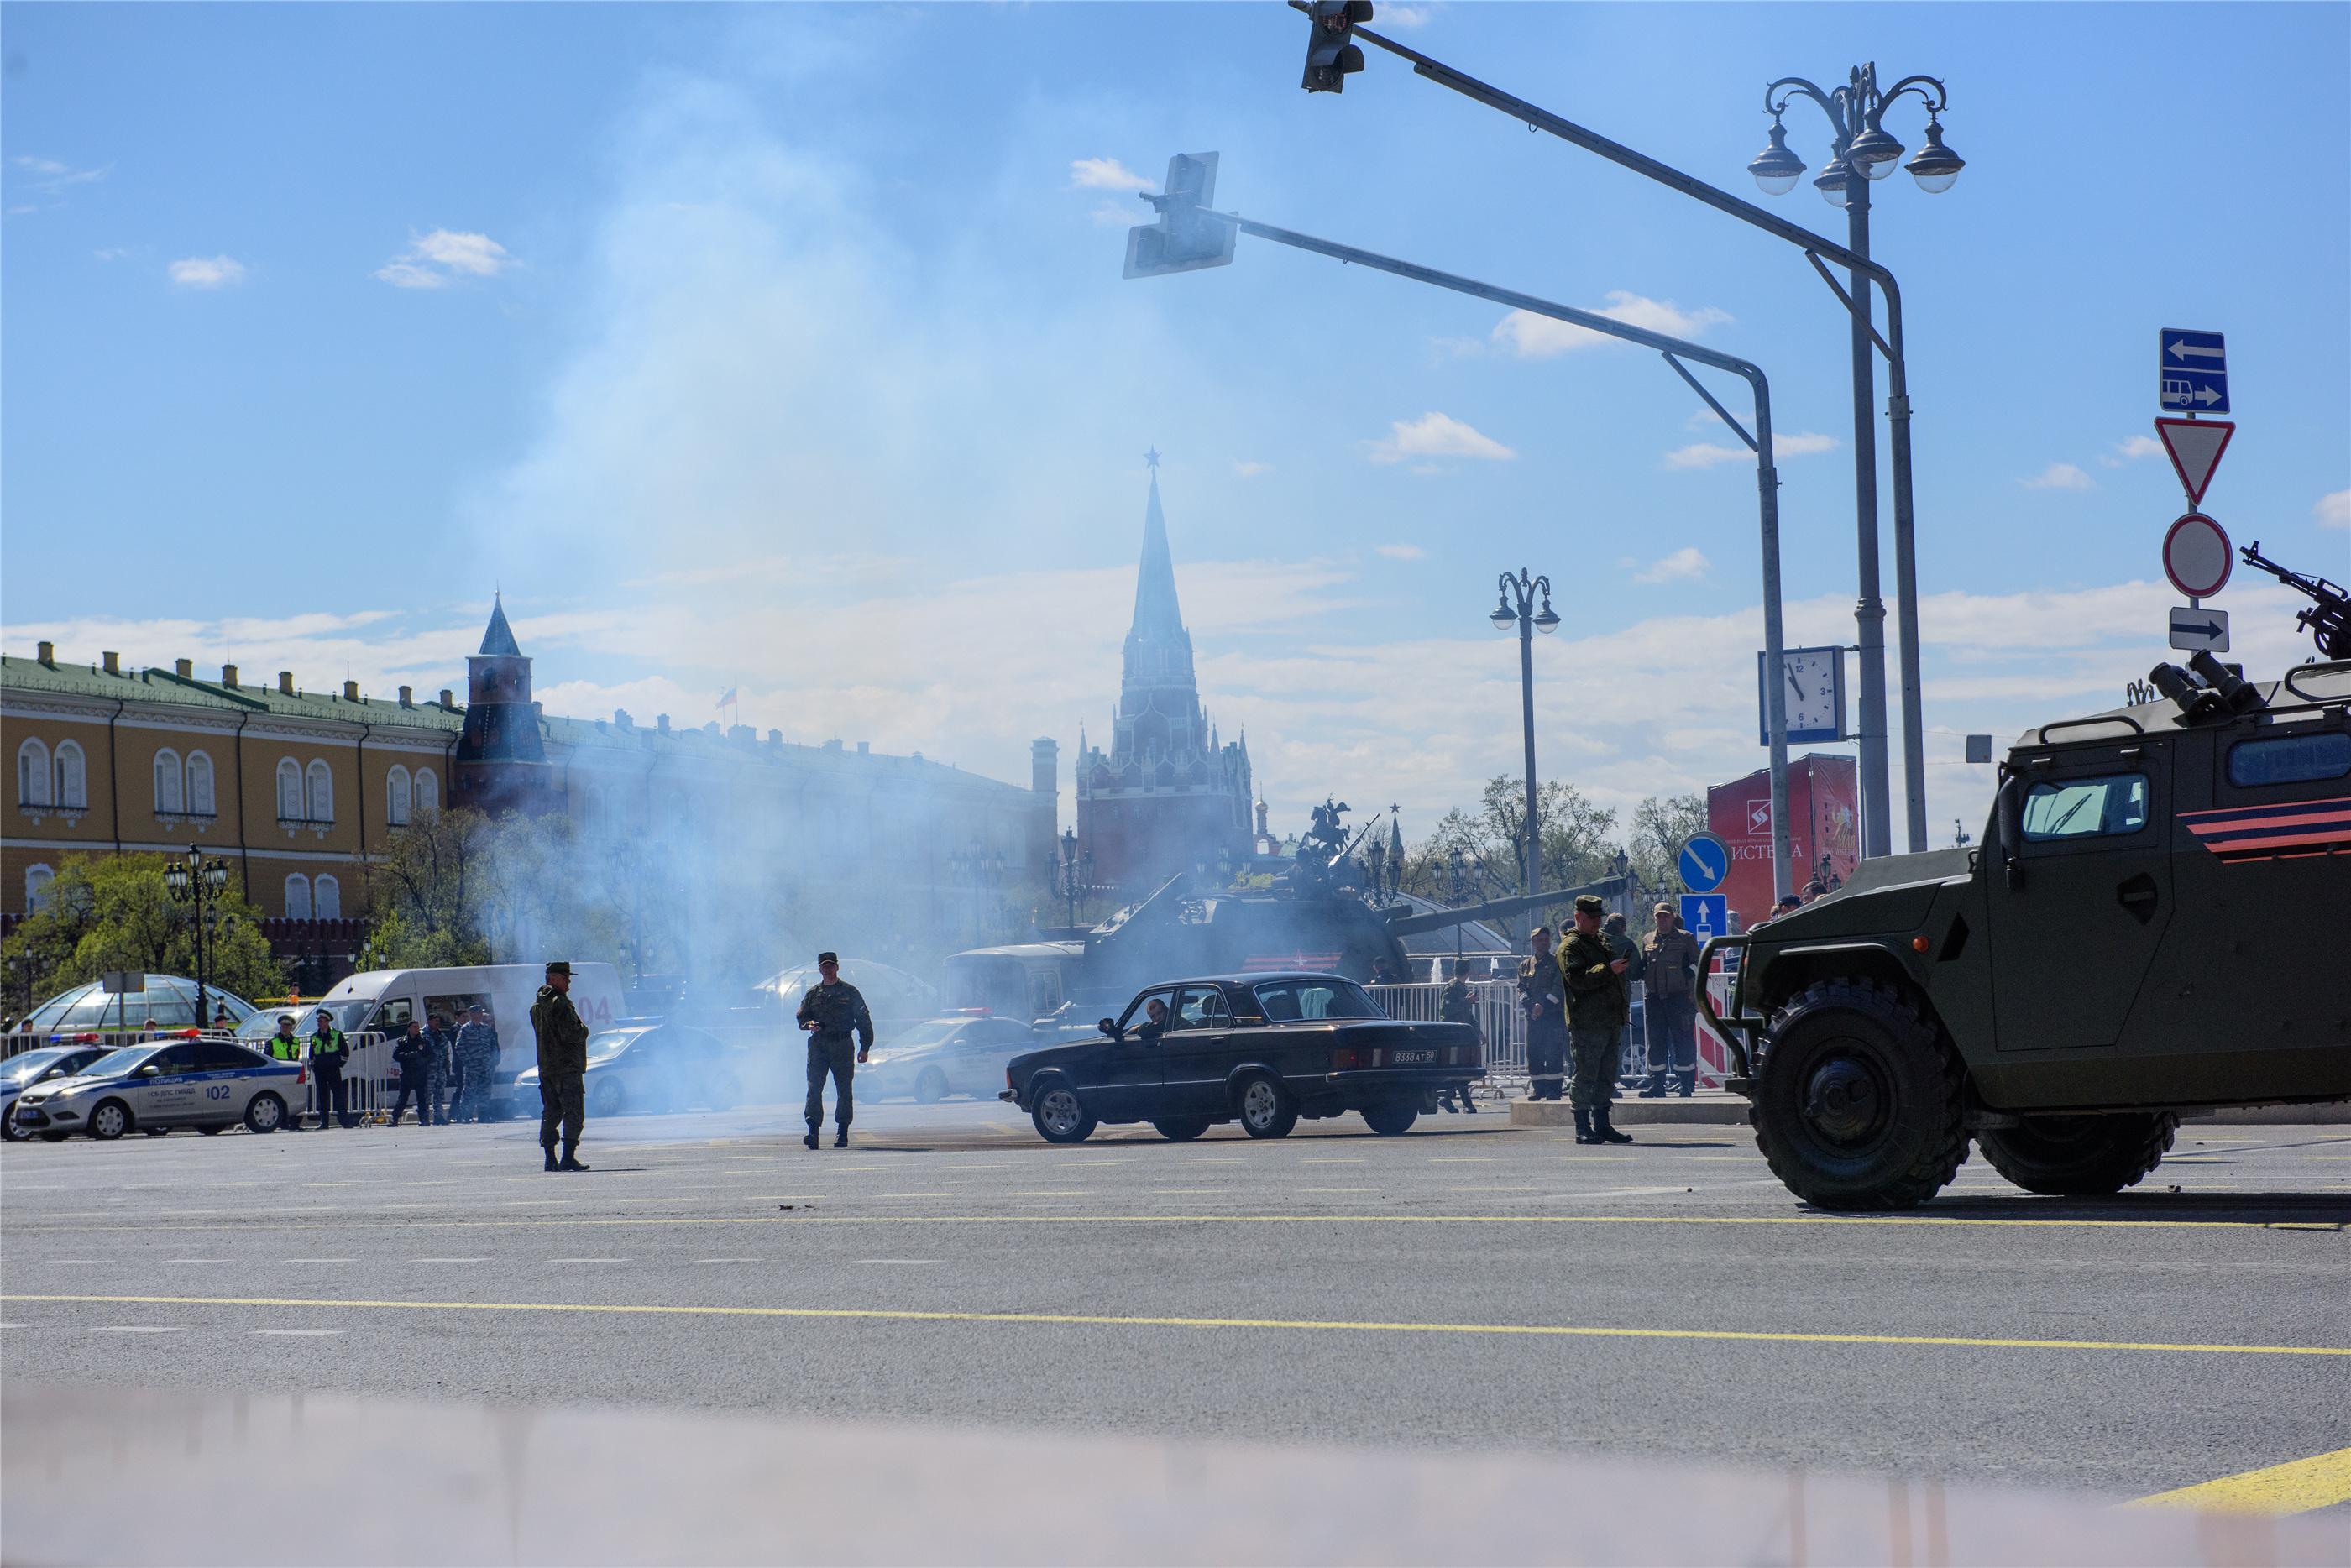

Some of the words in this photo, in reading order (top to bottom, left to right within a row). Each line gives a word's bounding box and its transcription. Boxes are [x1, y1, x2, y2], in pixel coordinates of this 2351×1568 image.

[1796, 665, 1804, 673] 12
[1731, 844, 1803, 860] ИСТЕА
[206, 1085, 230, 1100] 102
